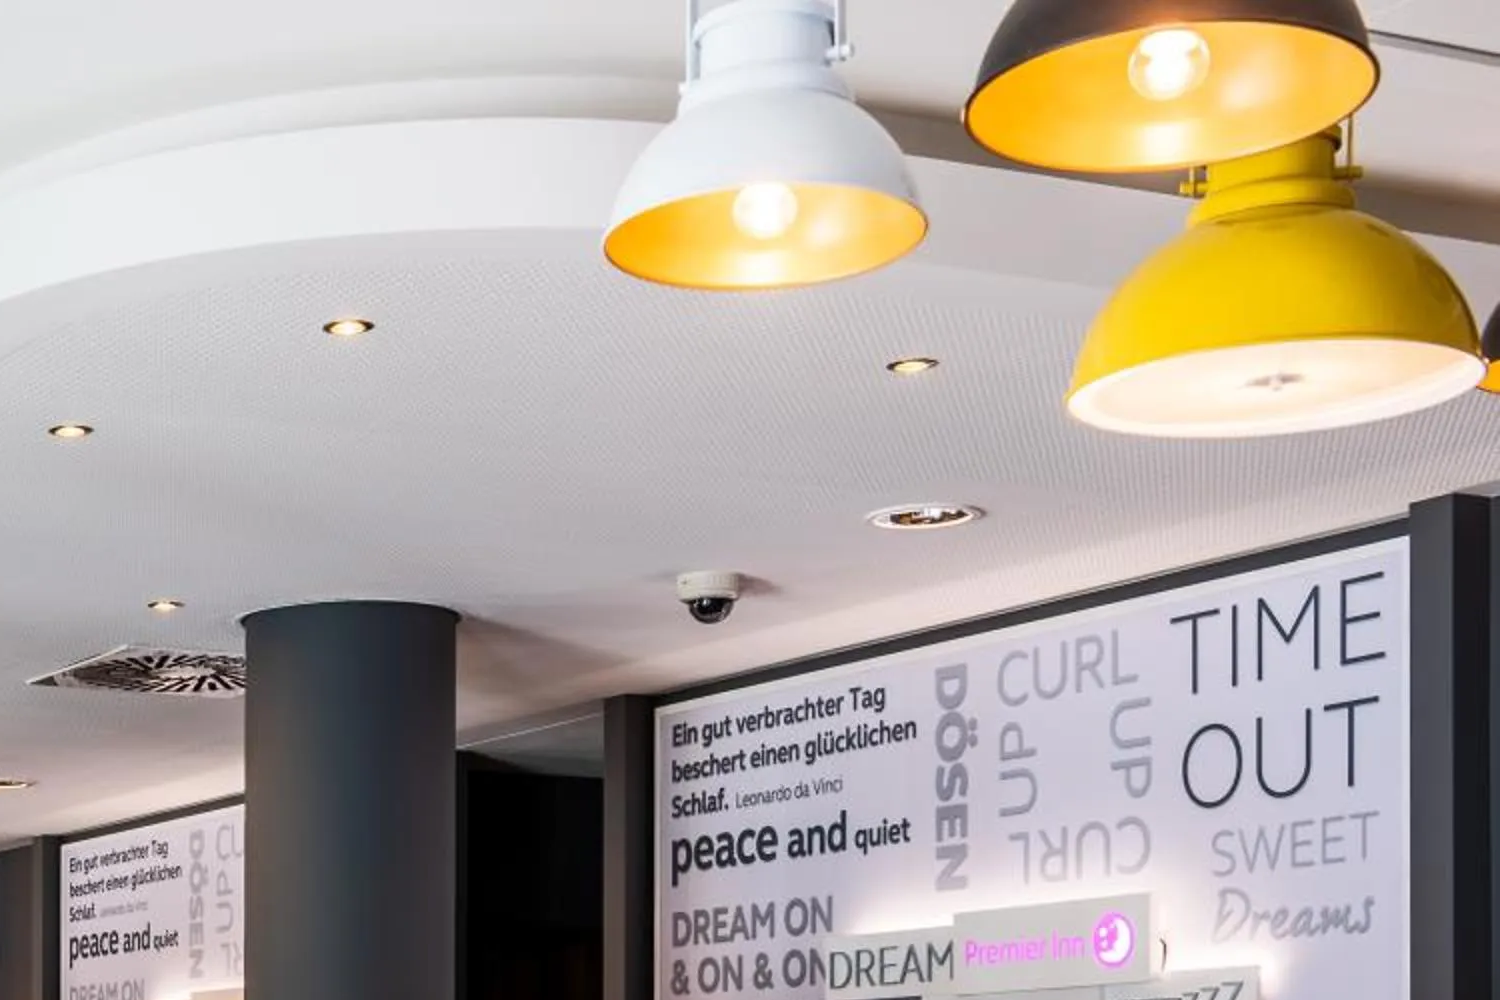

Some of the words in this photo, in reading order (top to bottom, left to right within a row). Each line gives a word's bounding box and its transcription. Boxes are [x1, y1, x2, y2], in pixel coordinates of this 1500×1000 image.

[1170, 571, 1386, 694] TIME
[997, 629, 1139, 706] CURL
[672, 724, 698, 747] Ein
[702, 715, 731, 747] gut
[736, 694, 844, 734] verbrachter
[849, 686, 886, 713] Tag
[1109, 696, 1152, 799] UP
[672, 750, 746, 783] beschert
[750, 741, 800, 769] einen
[804, 719, 917, 765] glücklichen
[934, 662, 978, 891] DÖSEN
[1182, 695, 1380, 808] OUT
[672, 787, 729, 818] Schlaf.
[735, 783, 792, 809] Leonardo
[794, 780, 811, 799] da
[813, 775, 844, 796] Vinci
[672, 823, 778, 887] peace
[787, 810, 847, 859] and
[855, 817, 911, 856] quiet
[1211, 810, 1380, 878] SWEET
[70, 929, 119, 969] peace
[123, 922, 150, 953] and
[672, 900, 775, 948] DREAM
[784, 895, 833, 936] ON
[1212, 886, 1375, 943] Dreams
[670, 958, 690, 996] &
[698, 955, 743, 994] ON
[753, 953, 774, 990] &
[829, 940, 954, 990] DREAM
[965, 936, 1046, 968] Premier
[1052, 929, 1086, 960] Inn
